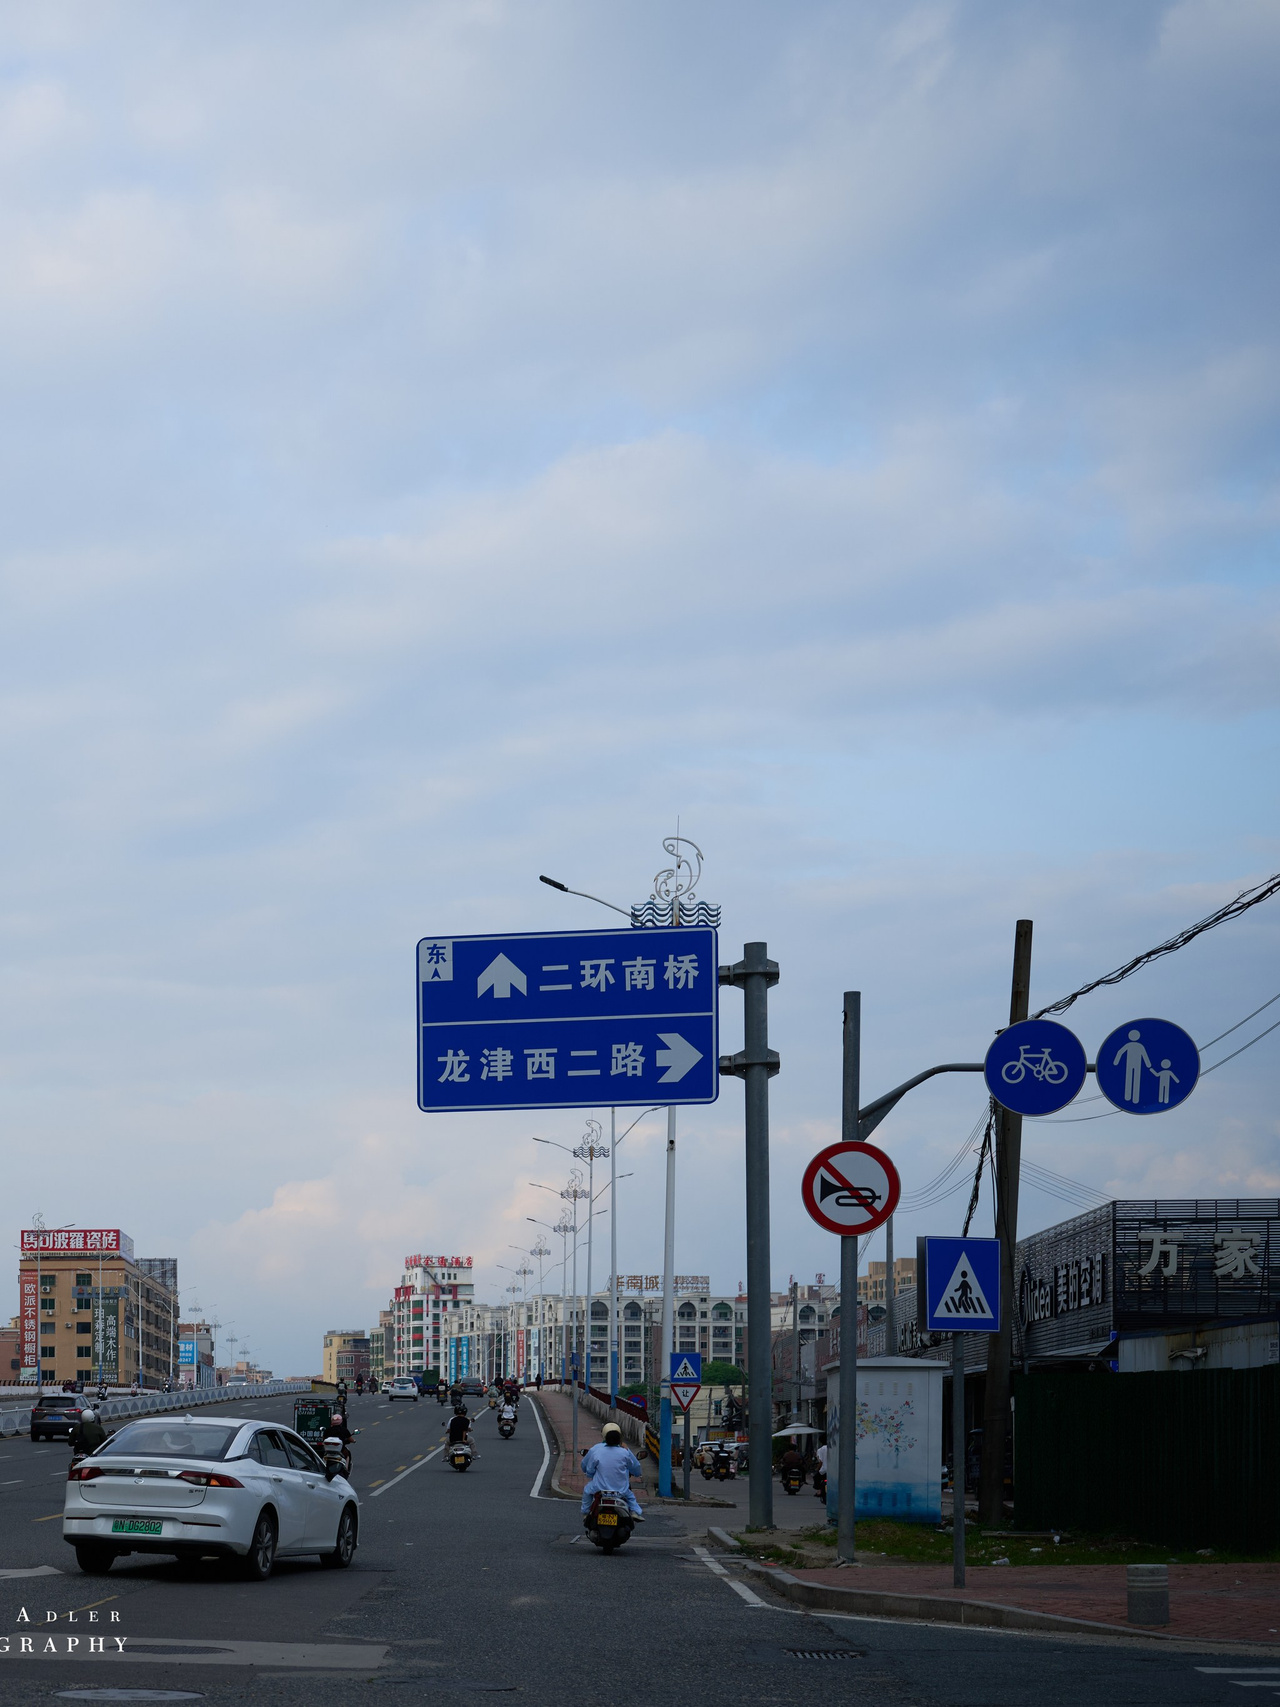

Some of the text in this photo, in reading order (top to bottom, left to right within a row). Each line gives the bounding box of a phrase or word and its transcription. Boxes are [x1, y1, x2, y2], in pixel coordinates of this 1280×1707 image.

[426, 943, 447, 965] 东
[539, 953, 700, 992] 二环南桥
[437, 1041, 645, 1083] 龙津西二路
[1137, 1227, 1262, 1279] 万家
[1057, 1252, 1103, 1314] 美的空调
[24, 1283, 36, 1366] 欧派不锈钢橱柜
[106, 1314, 117, 1361] 高端木作
[682, 1389, 689, 1398] 让
